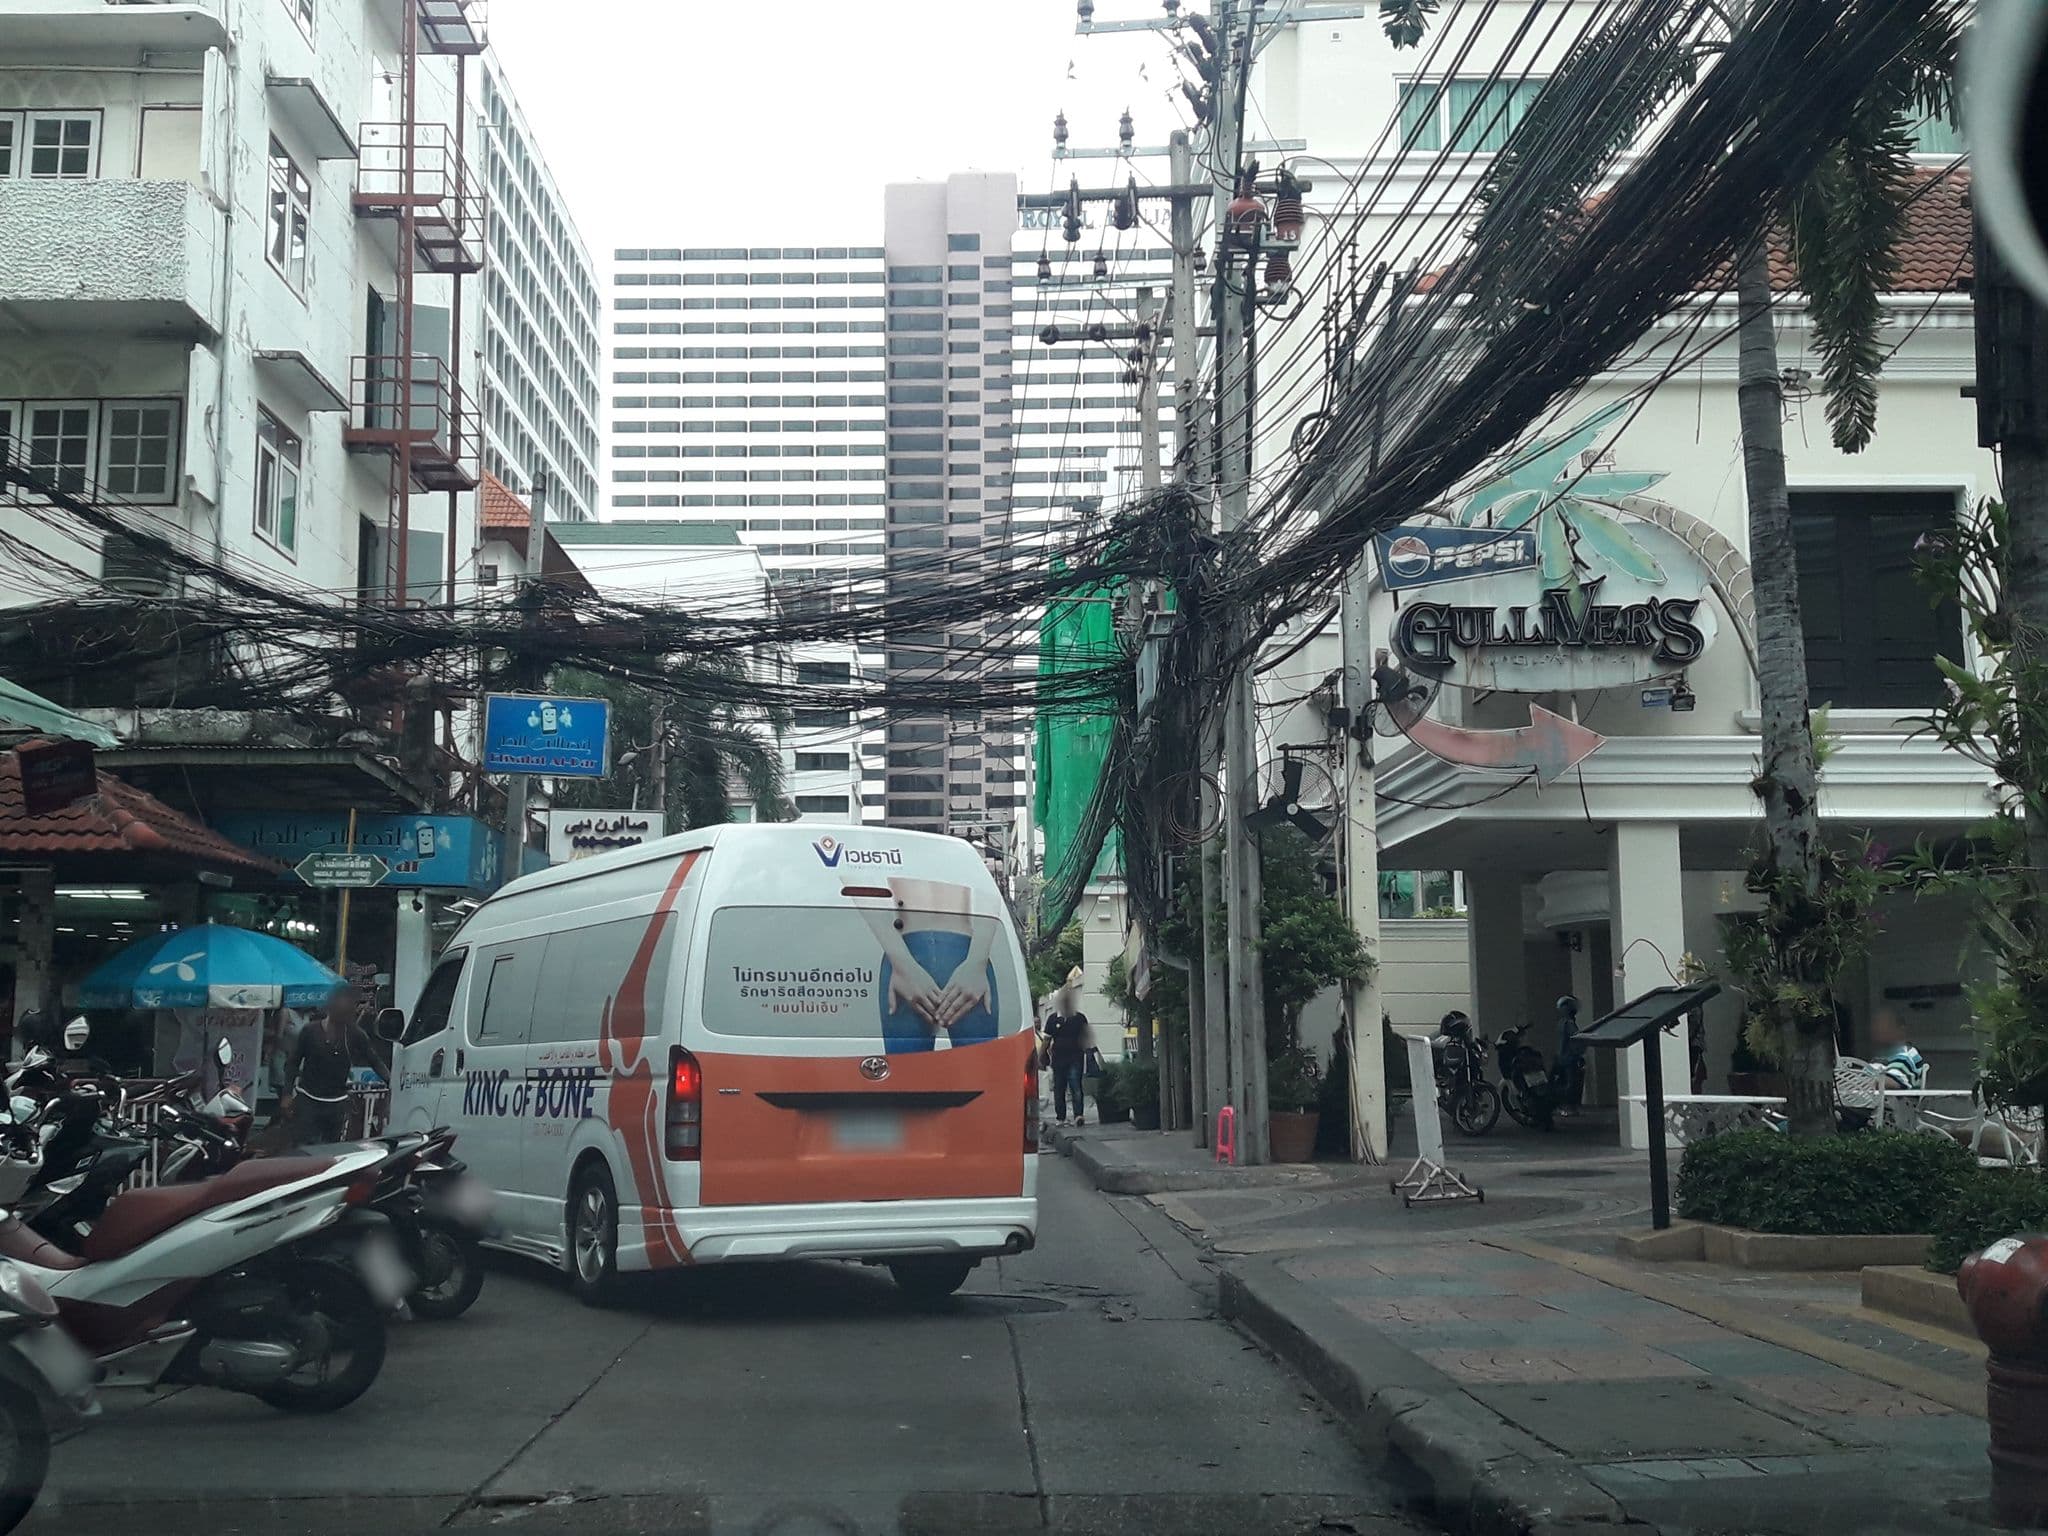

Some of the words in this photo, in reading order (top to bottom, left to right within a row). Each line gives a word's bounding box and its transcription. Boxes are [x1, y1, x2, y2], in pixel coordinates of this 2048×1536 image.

[1021, 209, 1095, 230] ROYL
[1283, 230, 1297, 240] 15
[1434, 539, 1525, 571] PEPSI
[1398, 575, 1706, 666] GULLIVER'S
[845, 848, 902, 865] เวชธานี
[733, 966, 873, 983] ไม่ทรมานอีกต่อไป
[740, 986, 869, 998] รักษาริดสีดวงทวาร
[463, 1069, 510, 1116] KING
[535, 1067, 595, 1118] BONE
